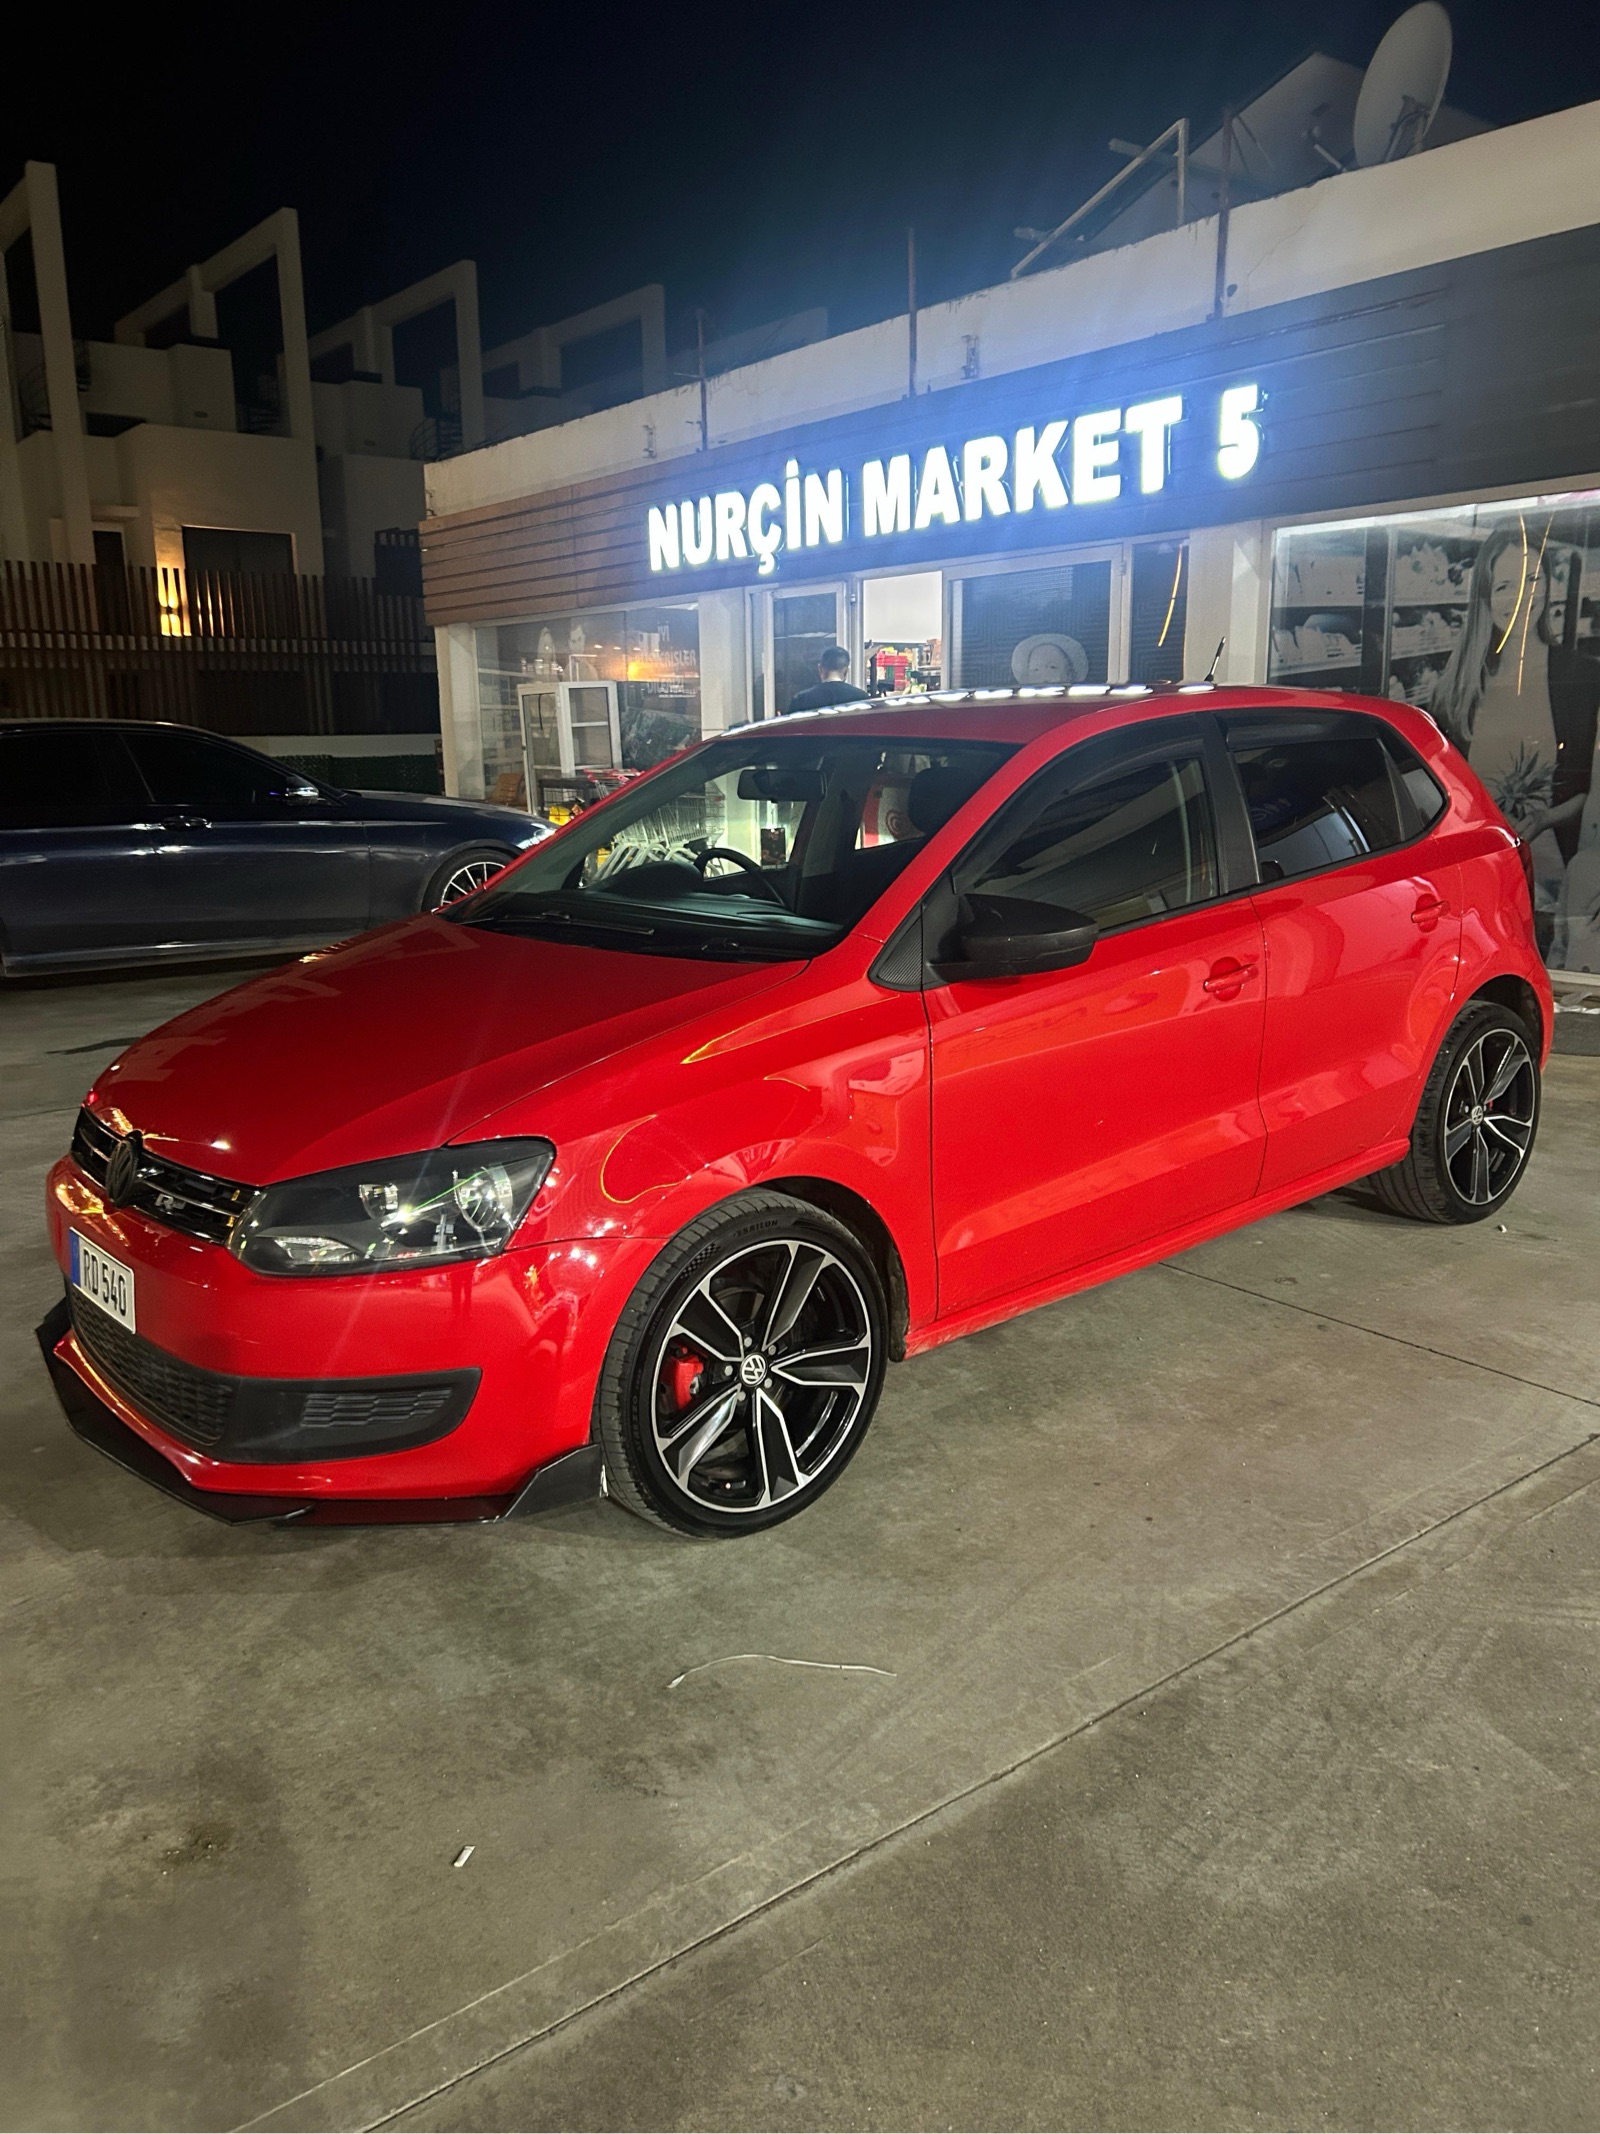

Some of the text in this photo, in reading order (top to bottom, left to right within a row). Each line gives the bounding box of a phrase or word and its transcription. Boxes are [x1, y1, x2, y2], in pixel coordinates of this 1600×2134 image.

[649, 384, 1259, 575] NURÇİN MARKET 5
[83, 1248, 127, 1316] RD 540
